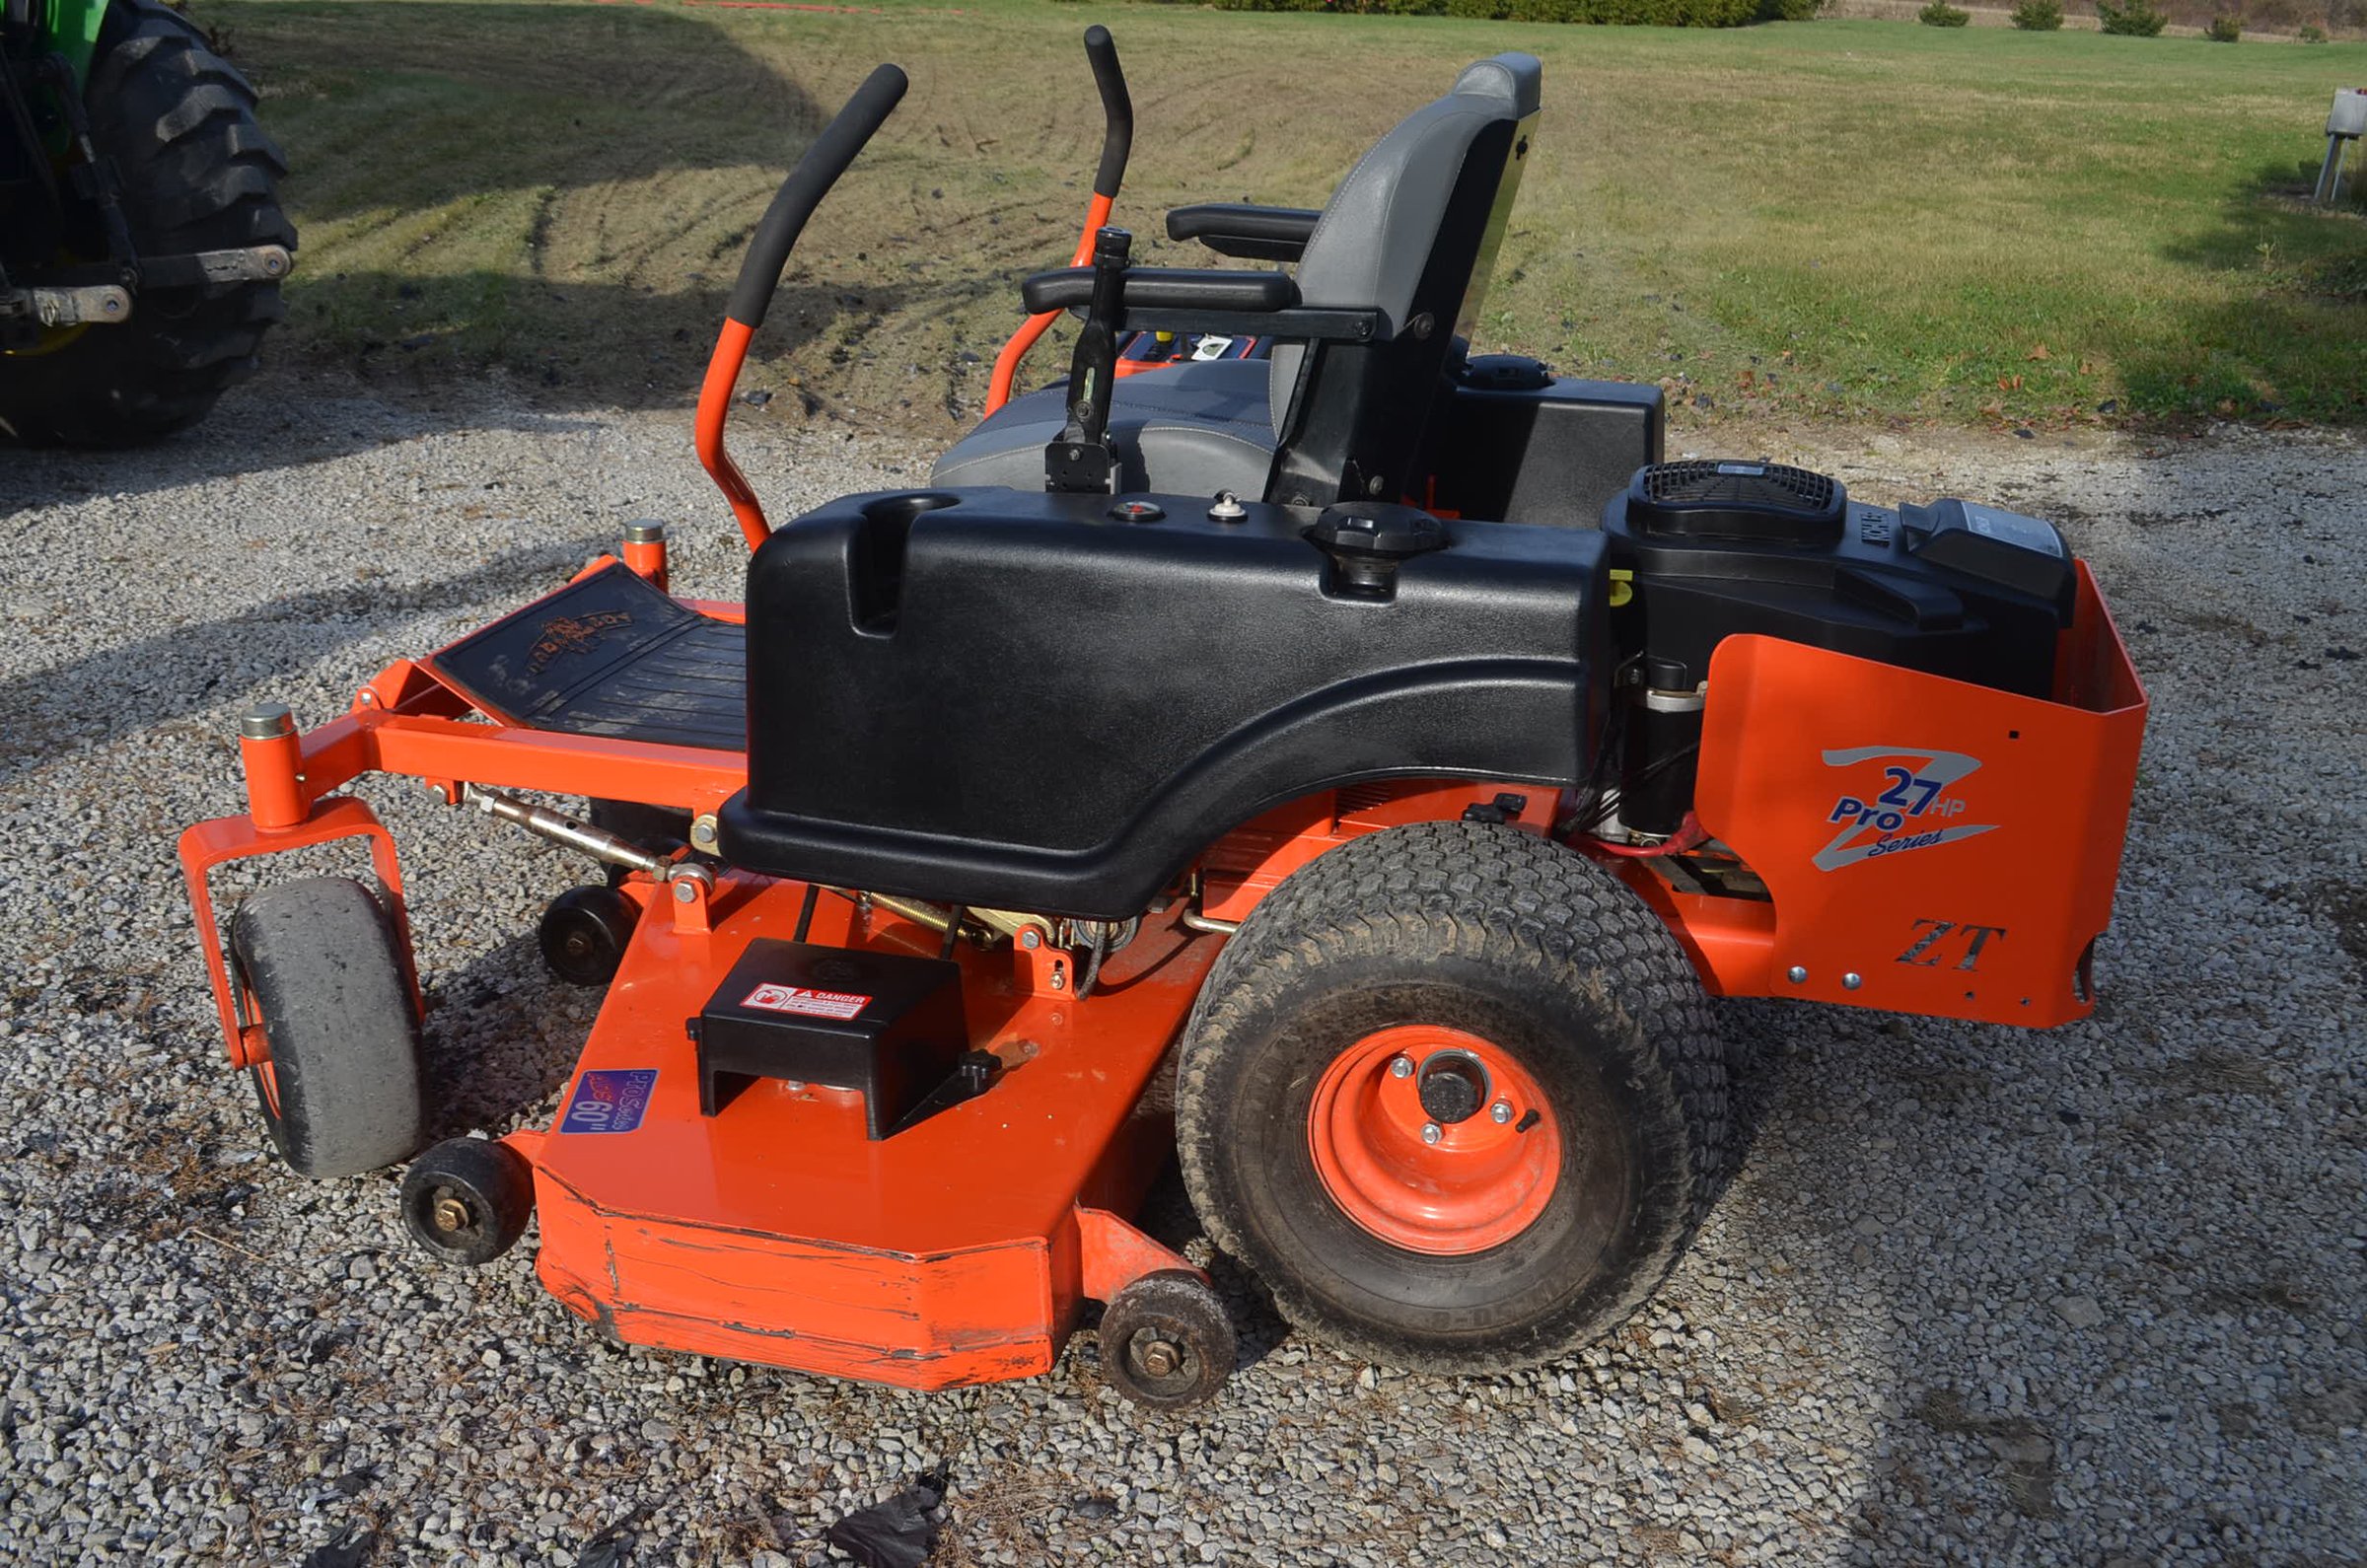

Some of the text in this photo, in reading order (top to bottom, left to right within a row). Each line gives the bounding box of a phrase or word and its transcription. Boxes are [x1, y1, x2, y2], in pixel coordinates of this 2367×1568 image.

[1879, 767, 1967, 818] 27 HP
[1827, 796, 1904, 831] Pro
[1867, 828, 1943, 857] Series
[1894, 918, 2007, 972] ZT
[816, 991, 866, 1004] DANGER
